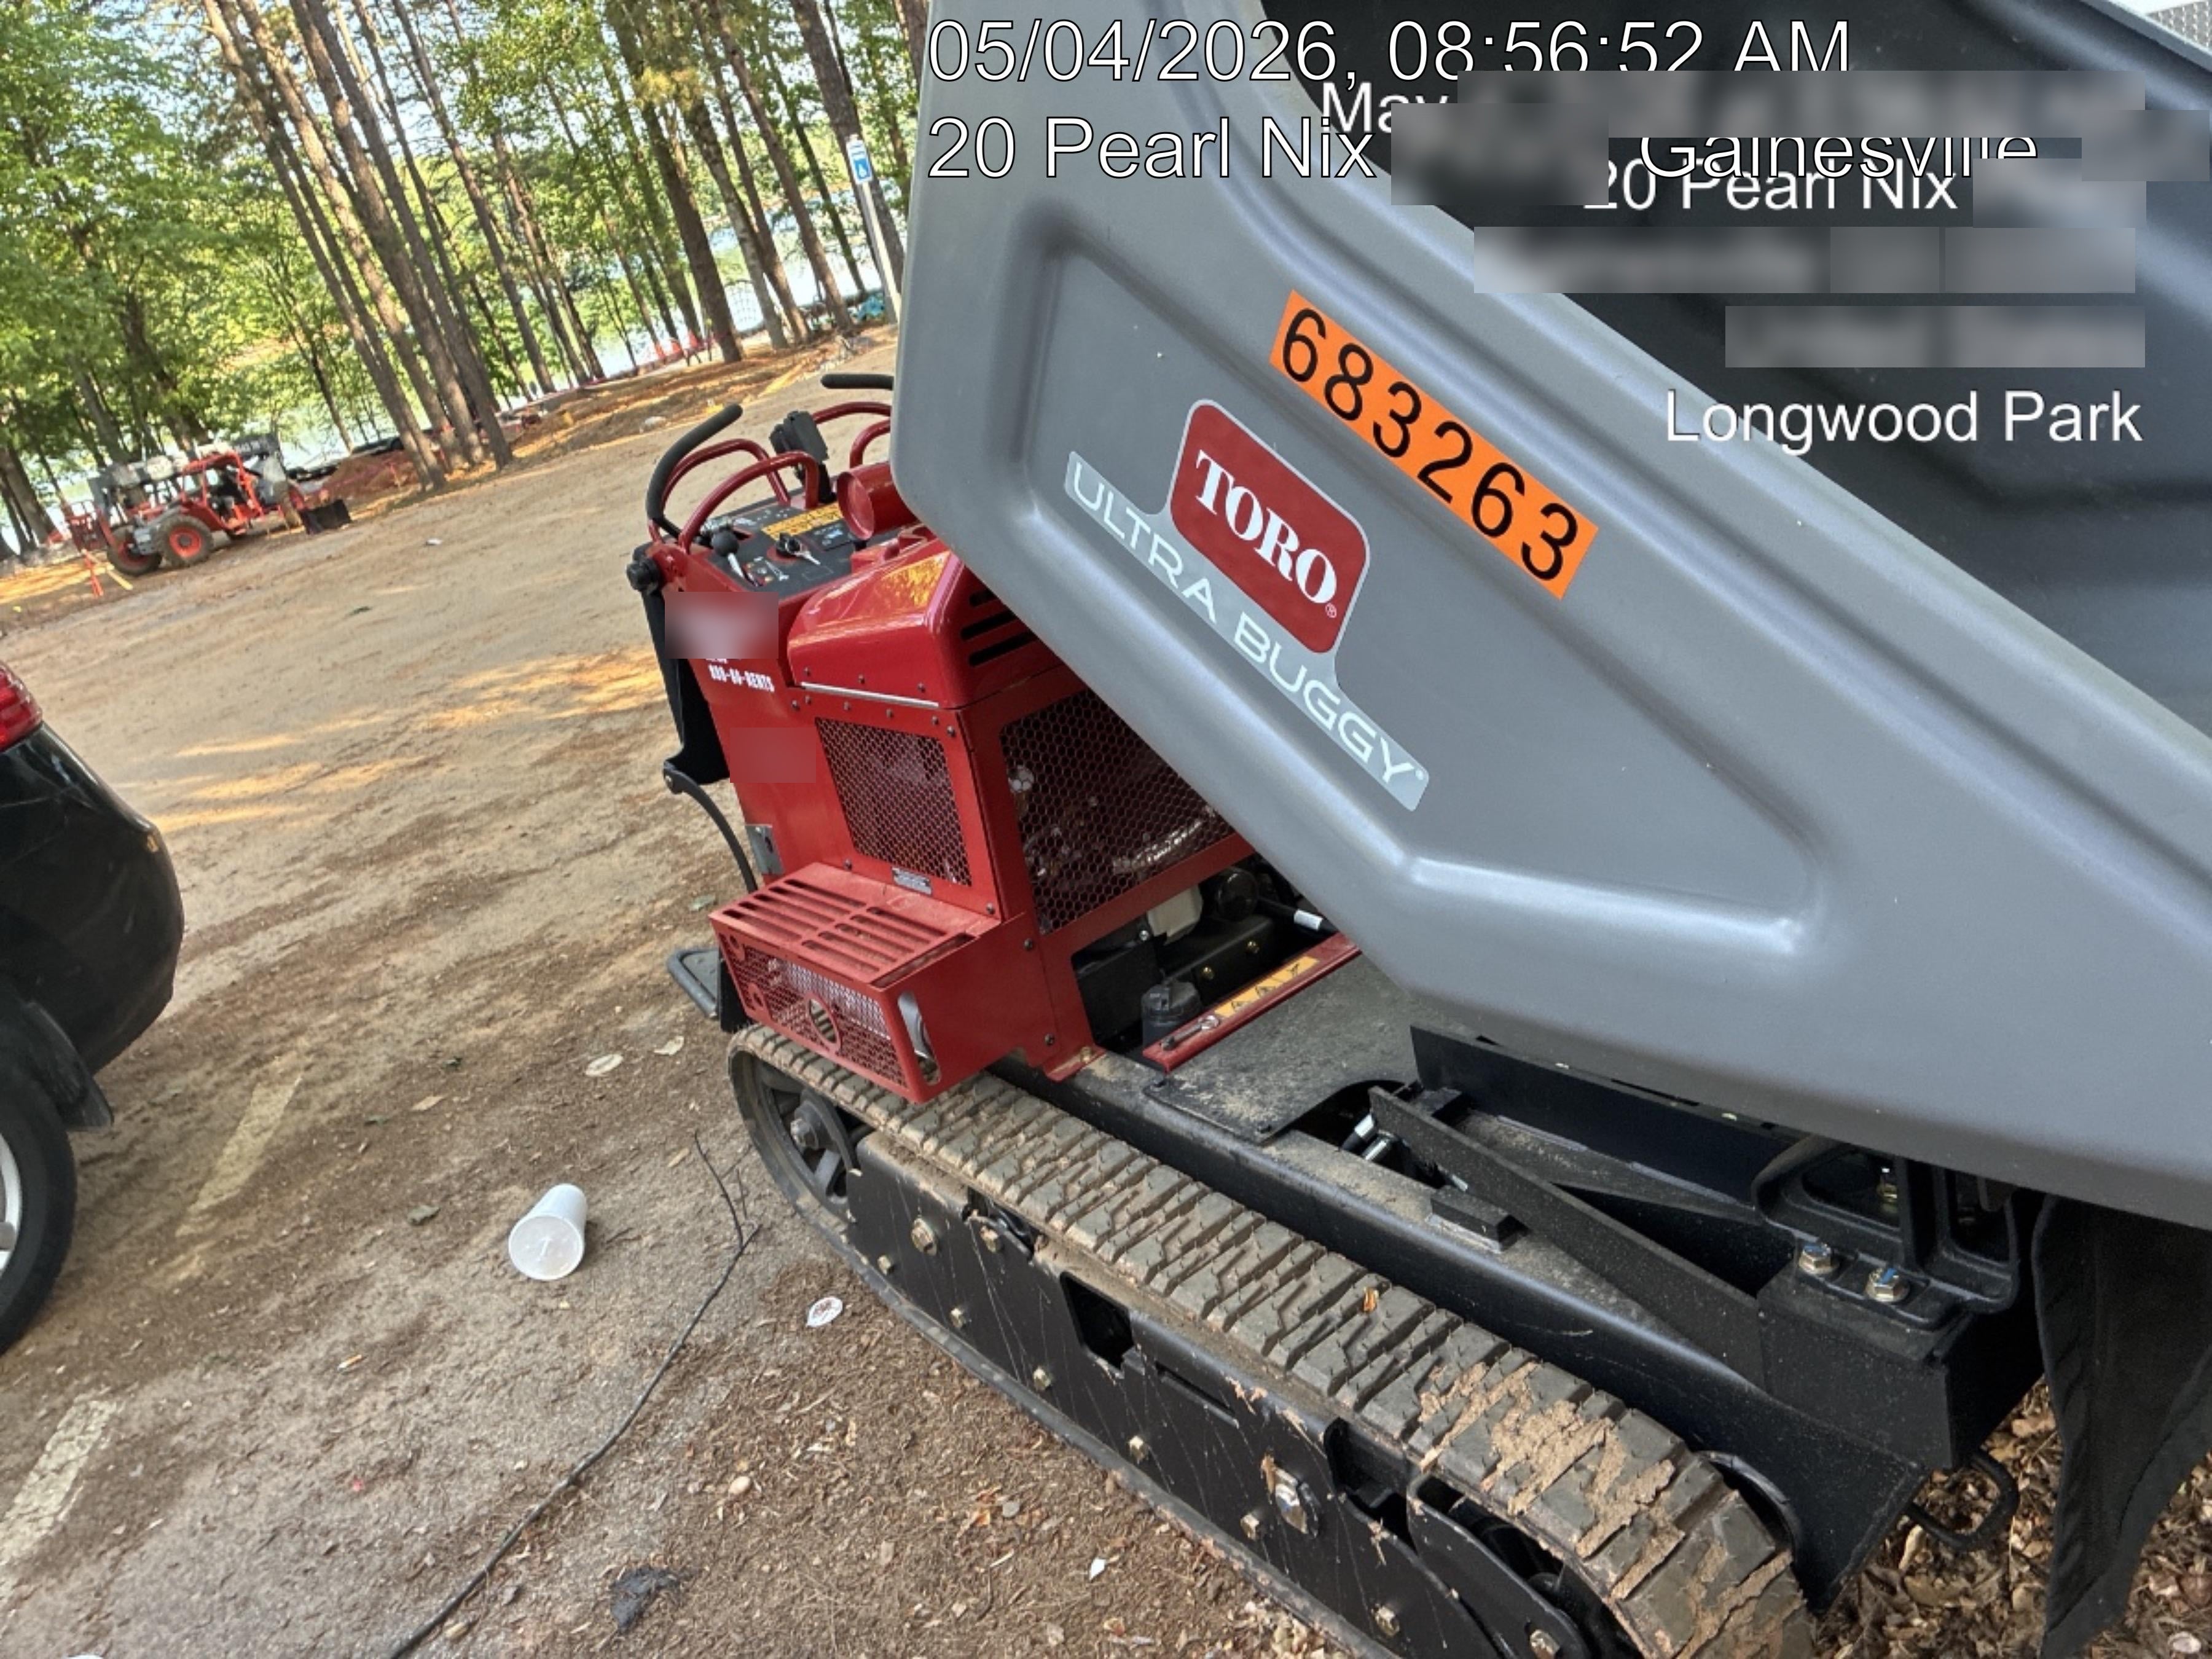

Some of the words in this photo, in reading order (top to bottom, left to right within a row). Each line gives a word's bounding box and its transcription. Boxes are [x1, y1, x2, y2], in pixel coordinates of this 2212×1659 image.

[1194, 449, 1338, 605] TORO
[1282, 308, 1578, 581] 683263
[1073, 461, 1217, 624] ULTRA
[1233, 611, 1414, 783] BUGGY
